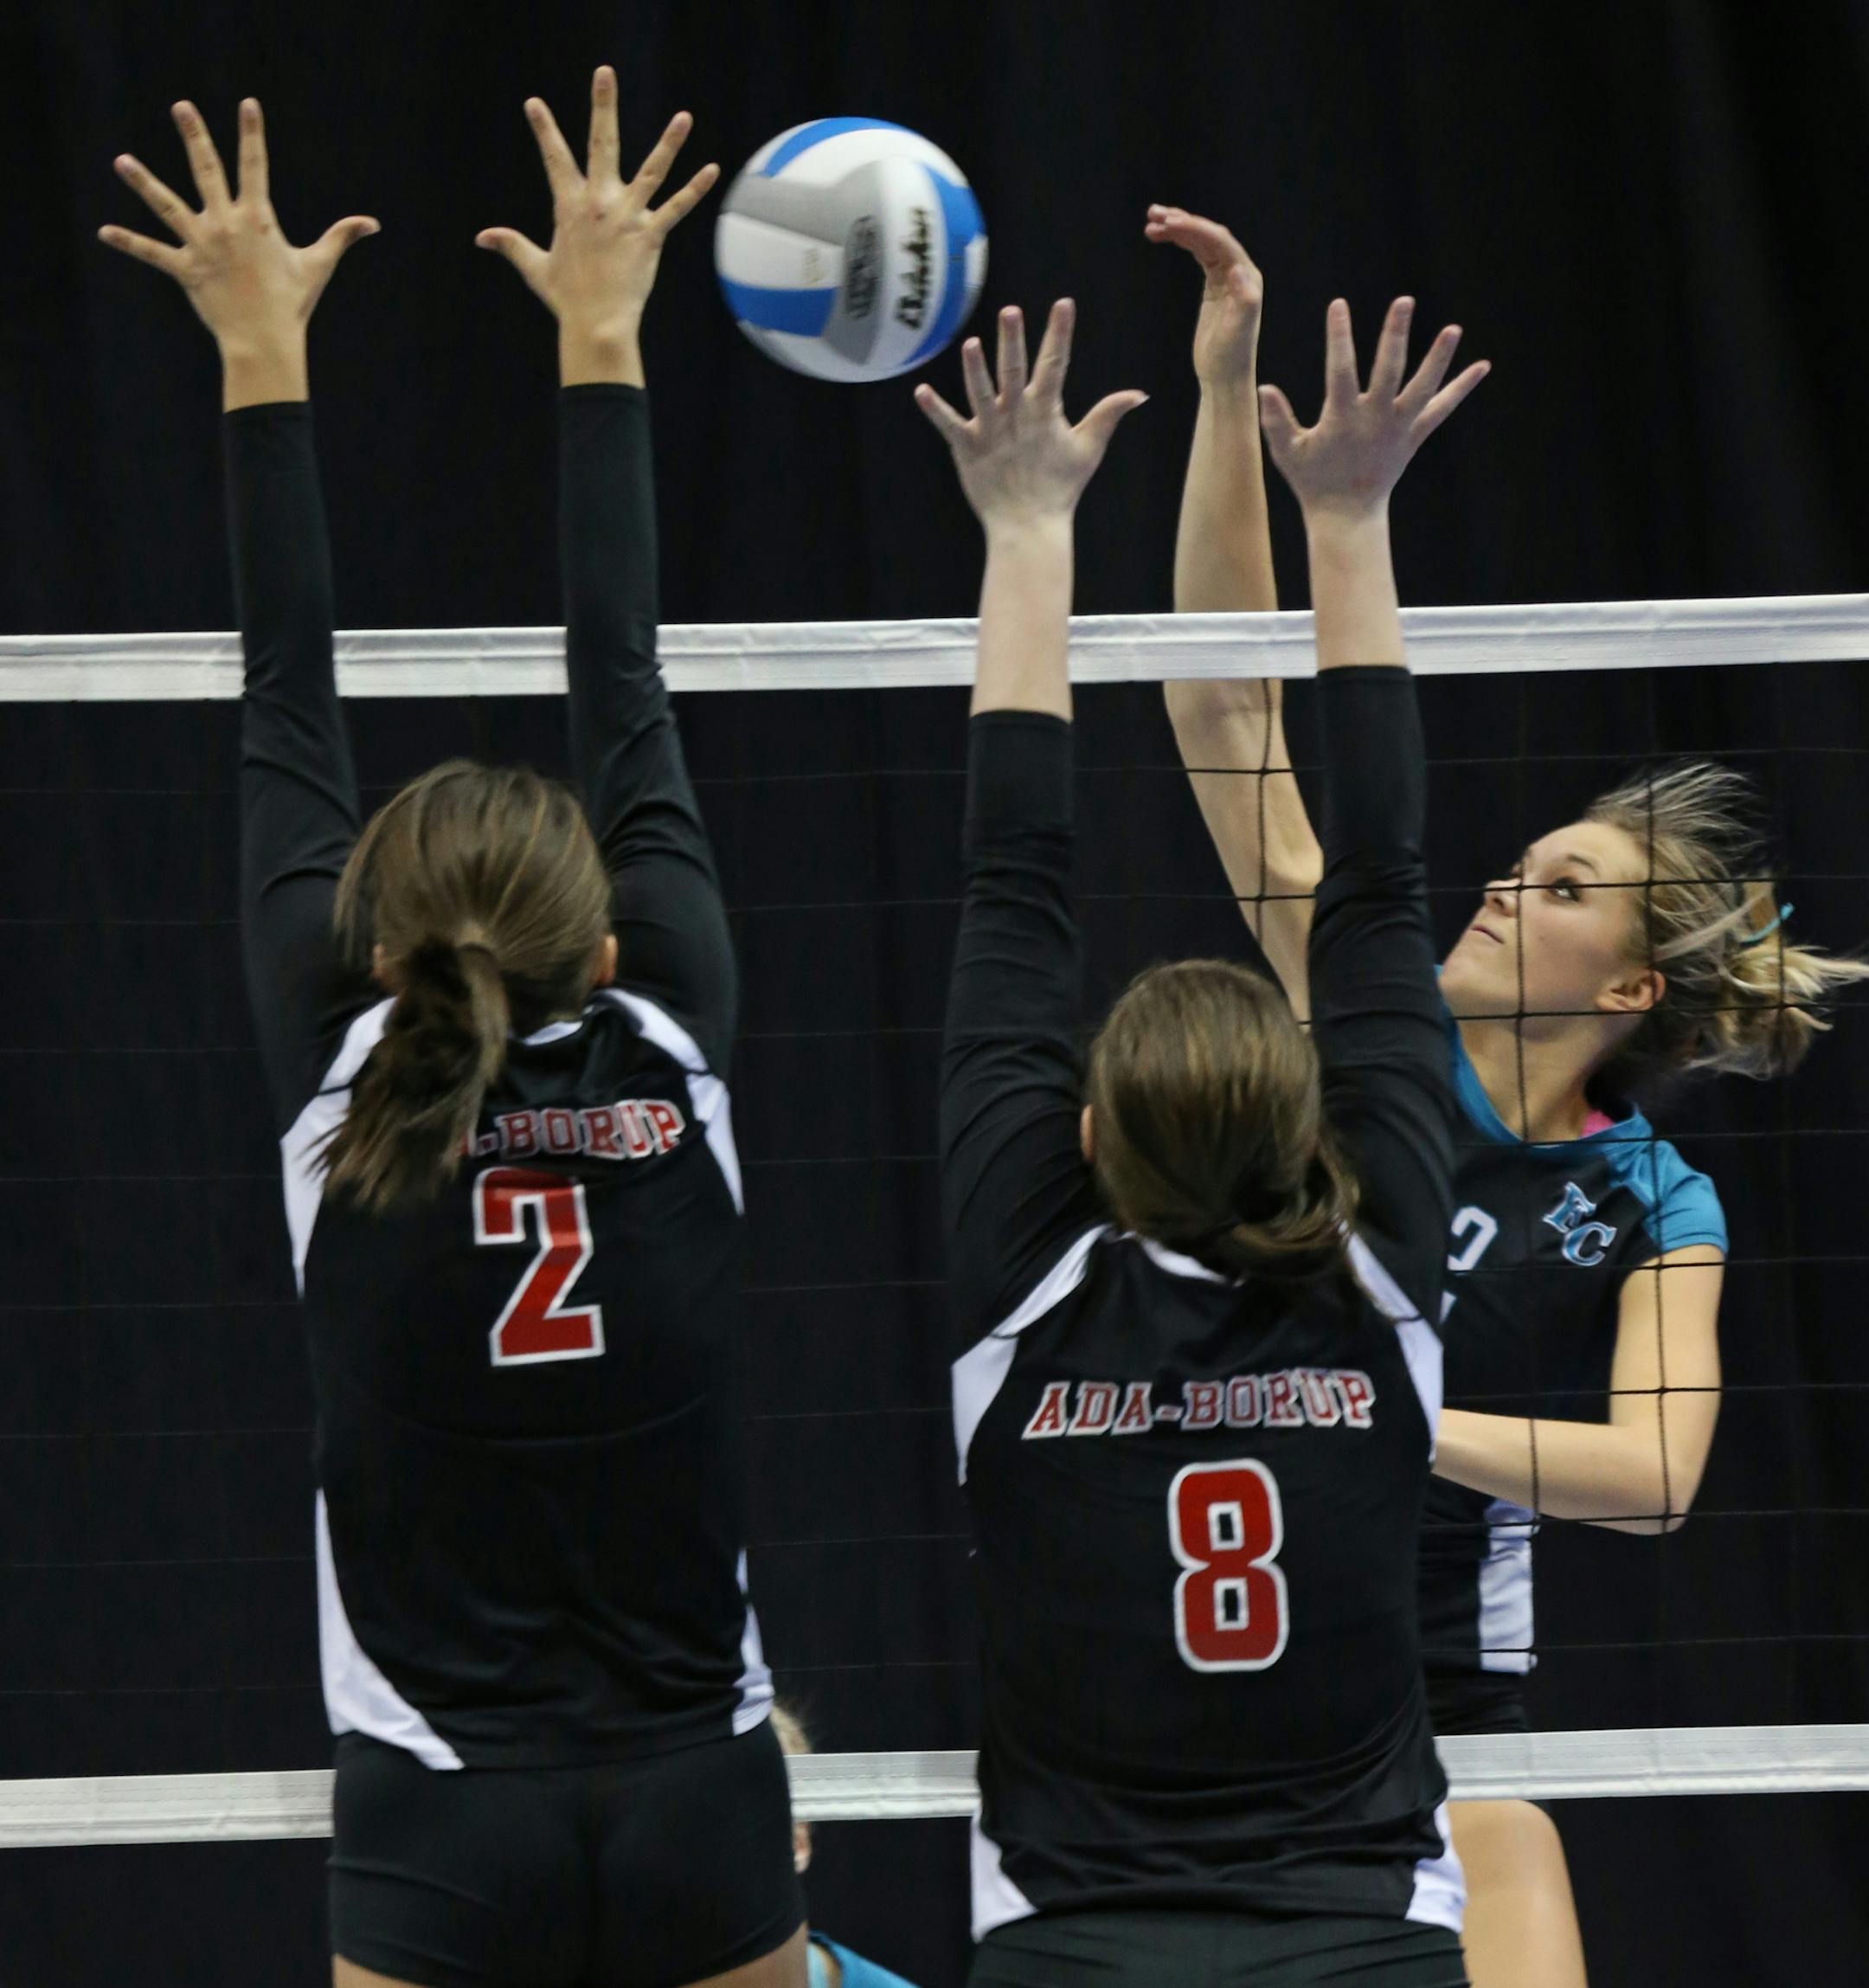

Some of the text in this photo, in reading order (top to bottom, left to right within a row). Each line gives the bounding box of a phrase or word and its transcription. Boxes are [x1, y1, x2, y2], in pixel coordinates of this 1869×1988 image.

[462, 1098, 687, 1161] -BORUP
[472, 1166, 607, 1367] 2
[1021, 1366, 1376, 1440] ADA-BORUP
[1167, 1457, 1290, 1673] 8
